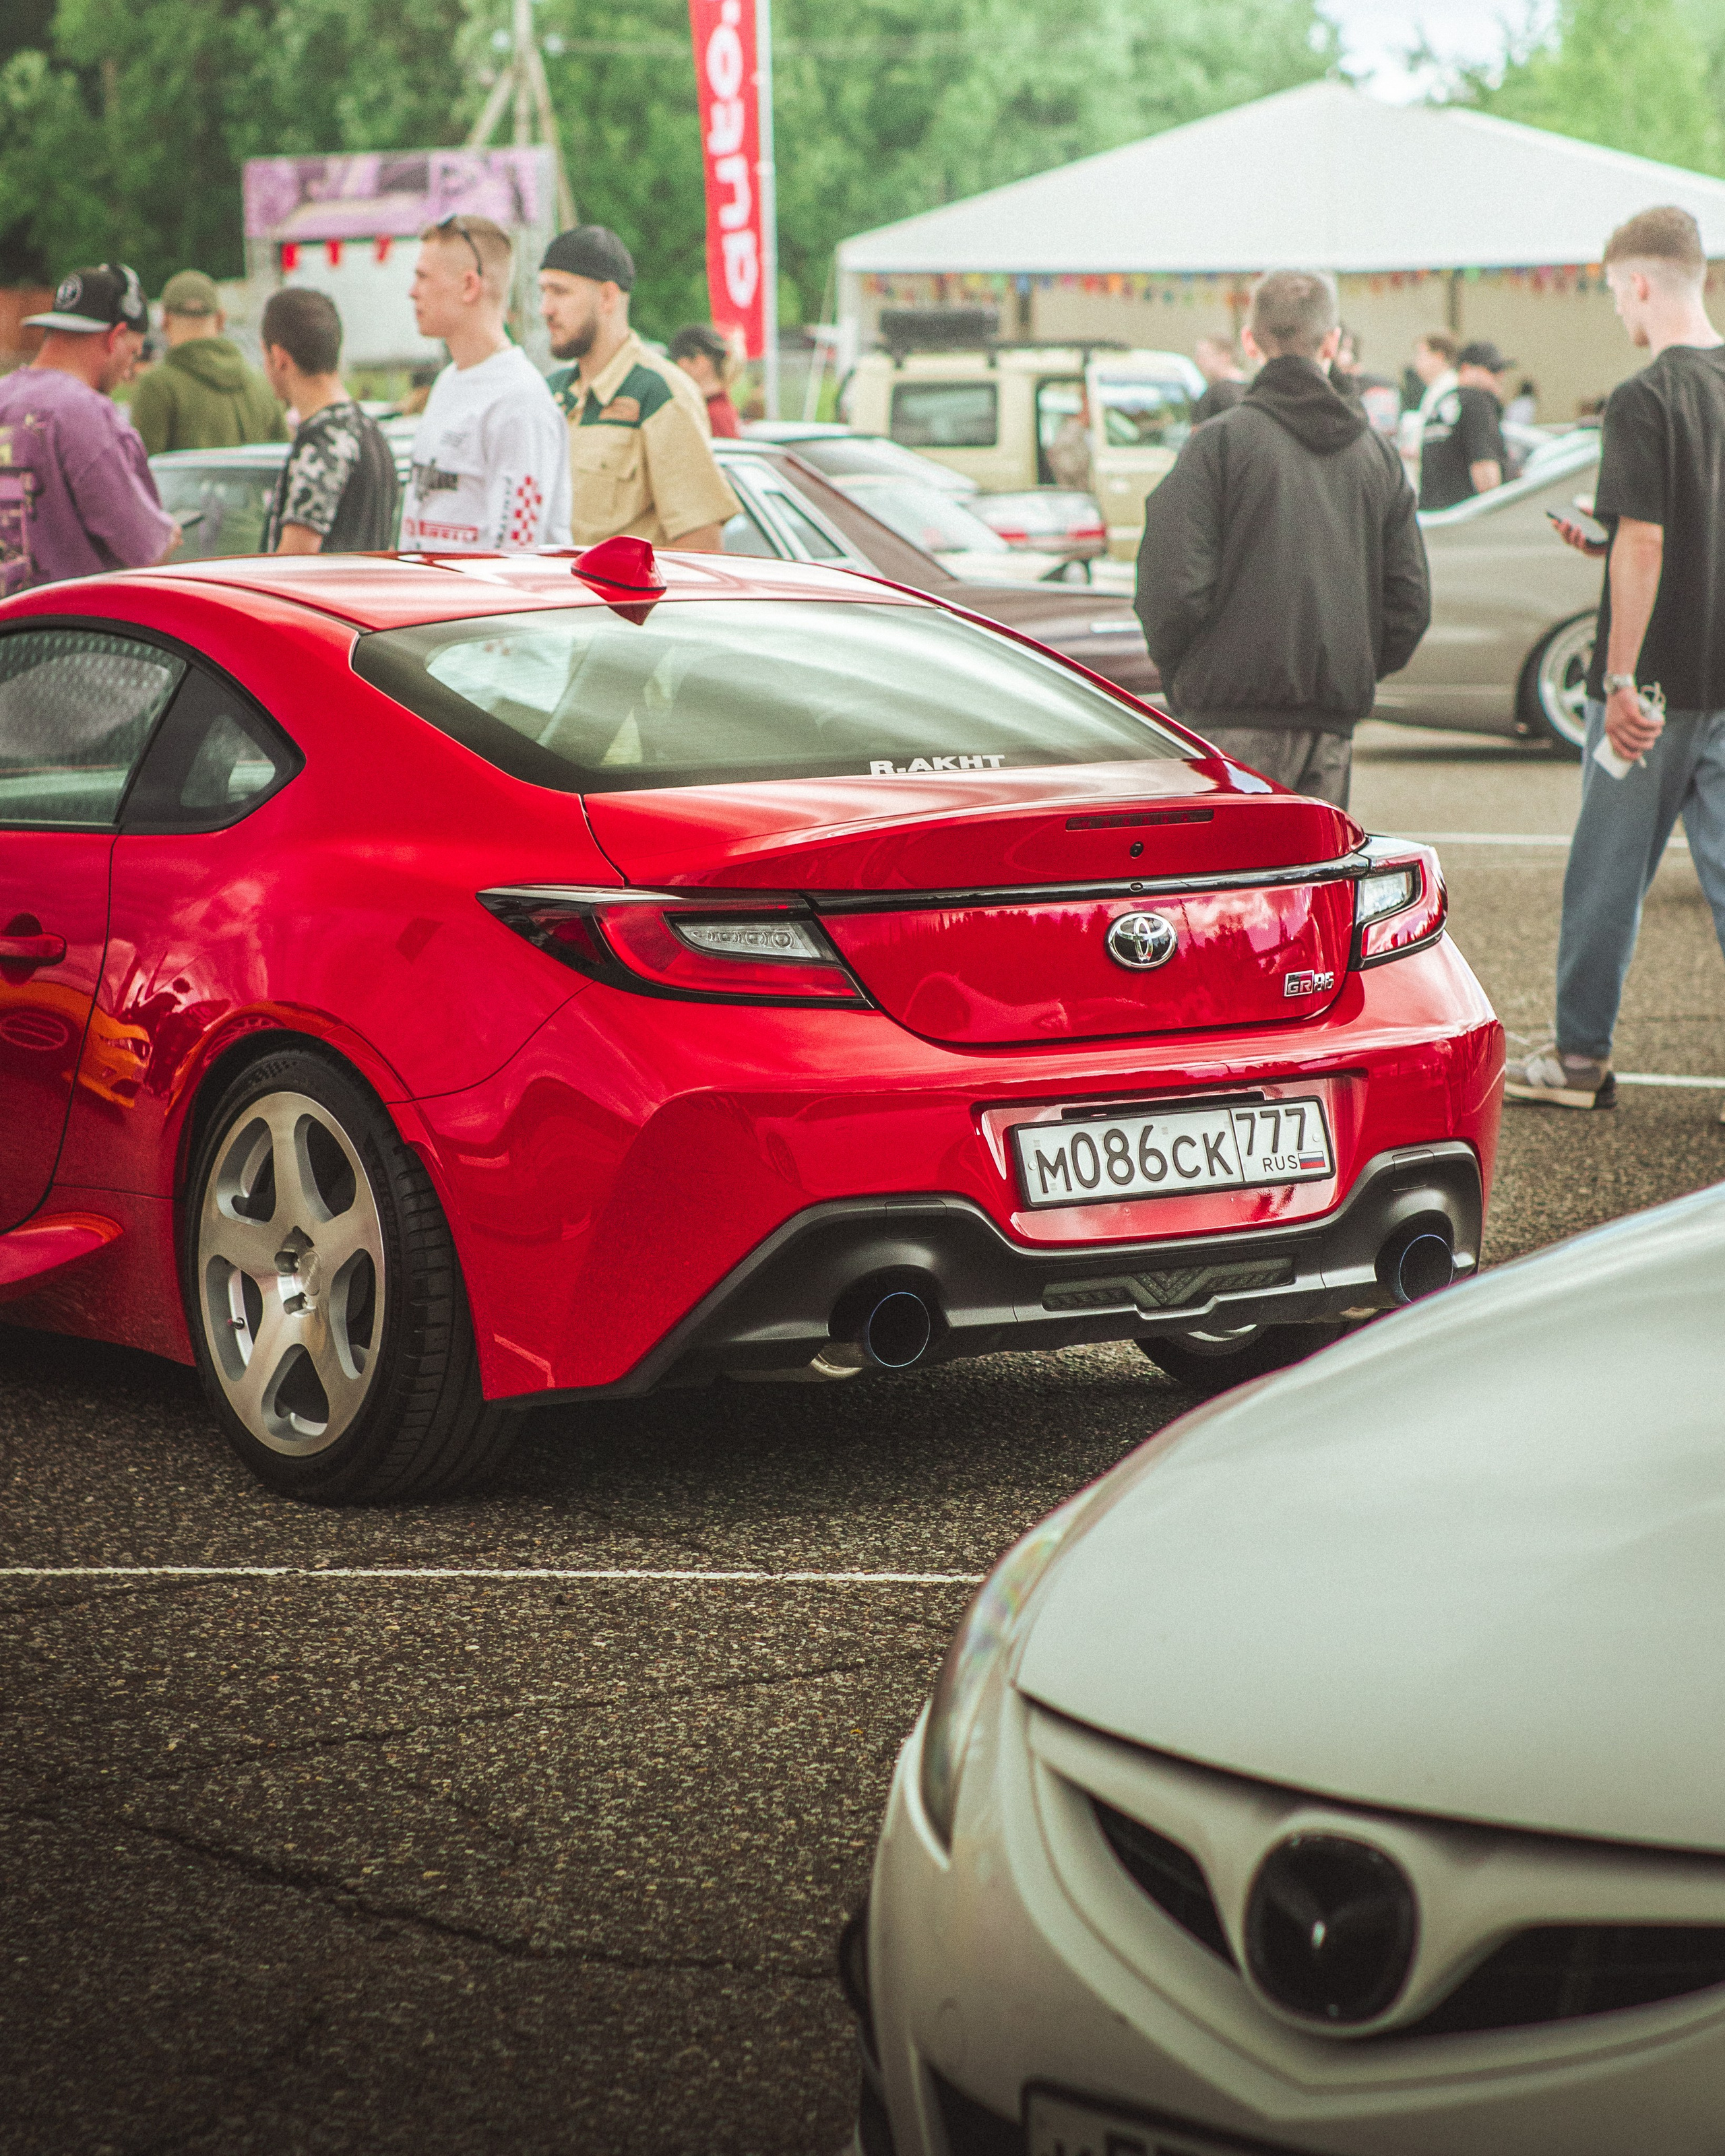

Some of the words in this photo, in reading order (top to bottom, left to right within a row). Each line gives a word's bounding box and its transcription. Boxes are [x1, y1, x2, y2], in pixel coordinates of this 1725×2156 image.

[869, 754, 1005, 775] R.AKHT
[1235, 1107, 1307, 1156] 777
[1262, 1156, 1298, 1172] RUS
